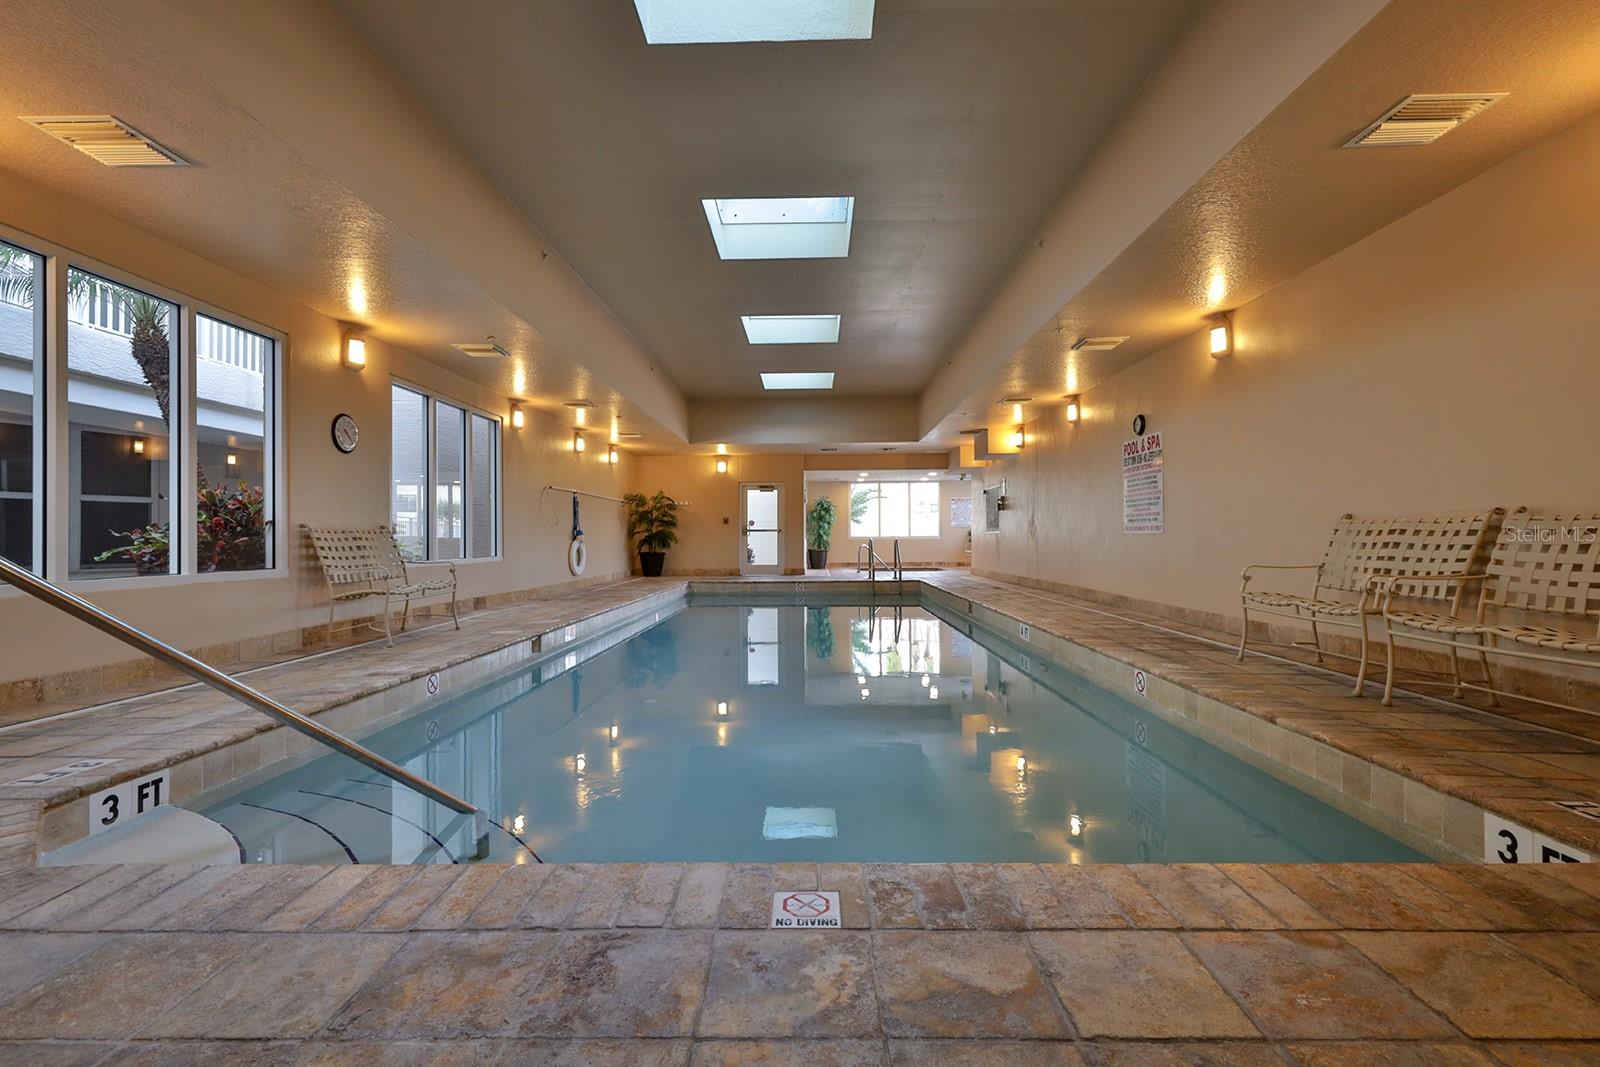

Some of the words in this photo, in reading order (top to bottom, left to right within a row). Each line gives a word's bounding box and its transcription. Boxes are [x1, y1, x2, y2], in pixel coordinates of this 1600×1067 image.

[1123, 441, 1139, 456] POOL
[1141, 438, 1146, 452] &
[1147, 434, 1160, 450] SPA
[101, 794, 119, 826] 3
[137, 776, 164, 814] FT
[1497, 829, 1518, 863] 3
[775, 918, 792, 926] NO
[797, 918, 838, 926] DIVING
